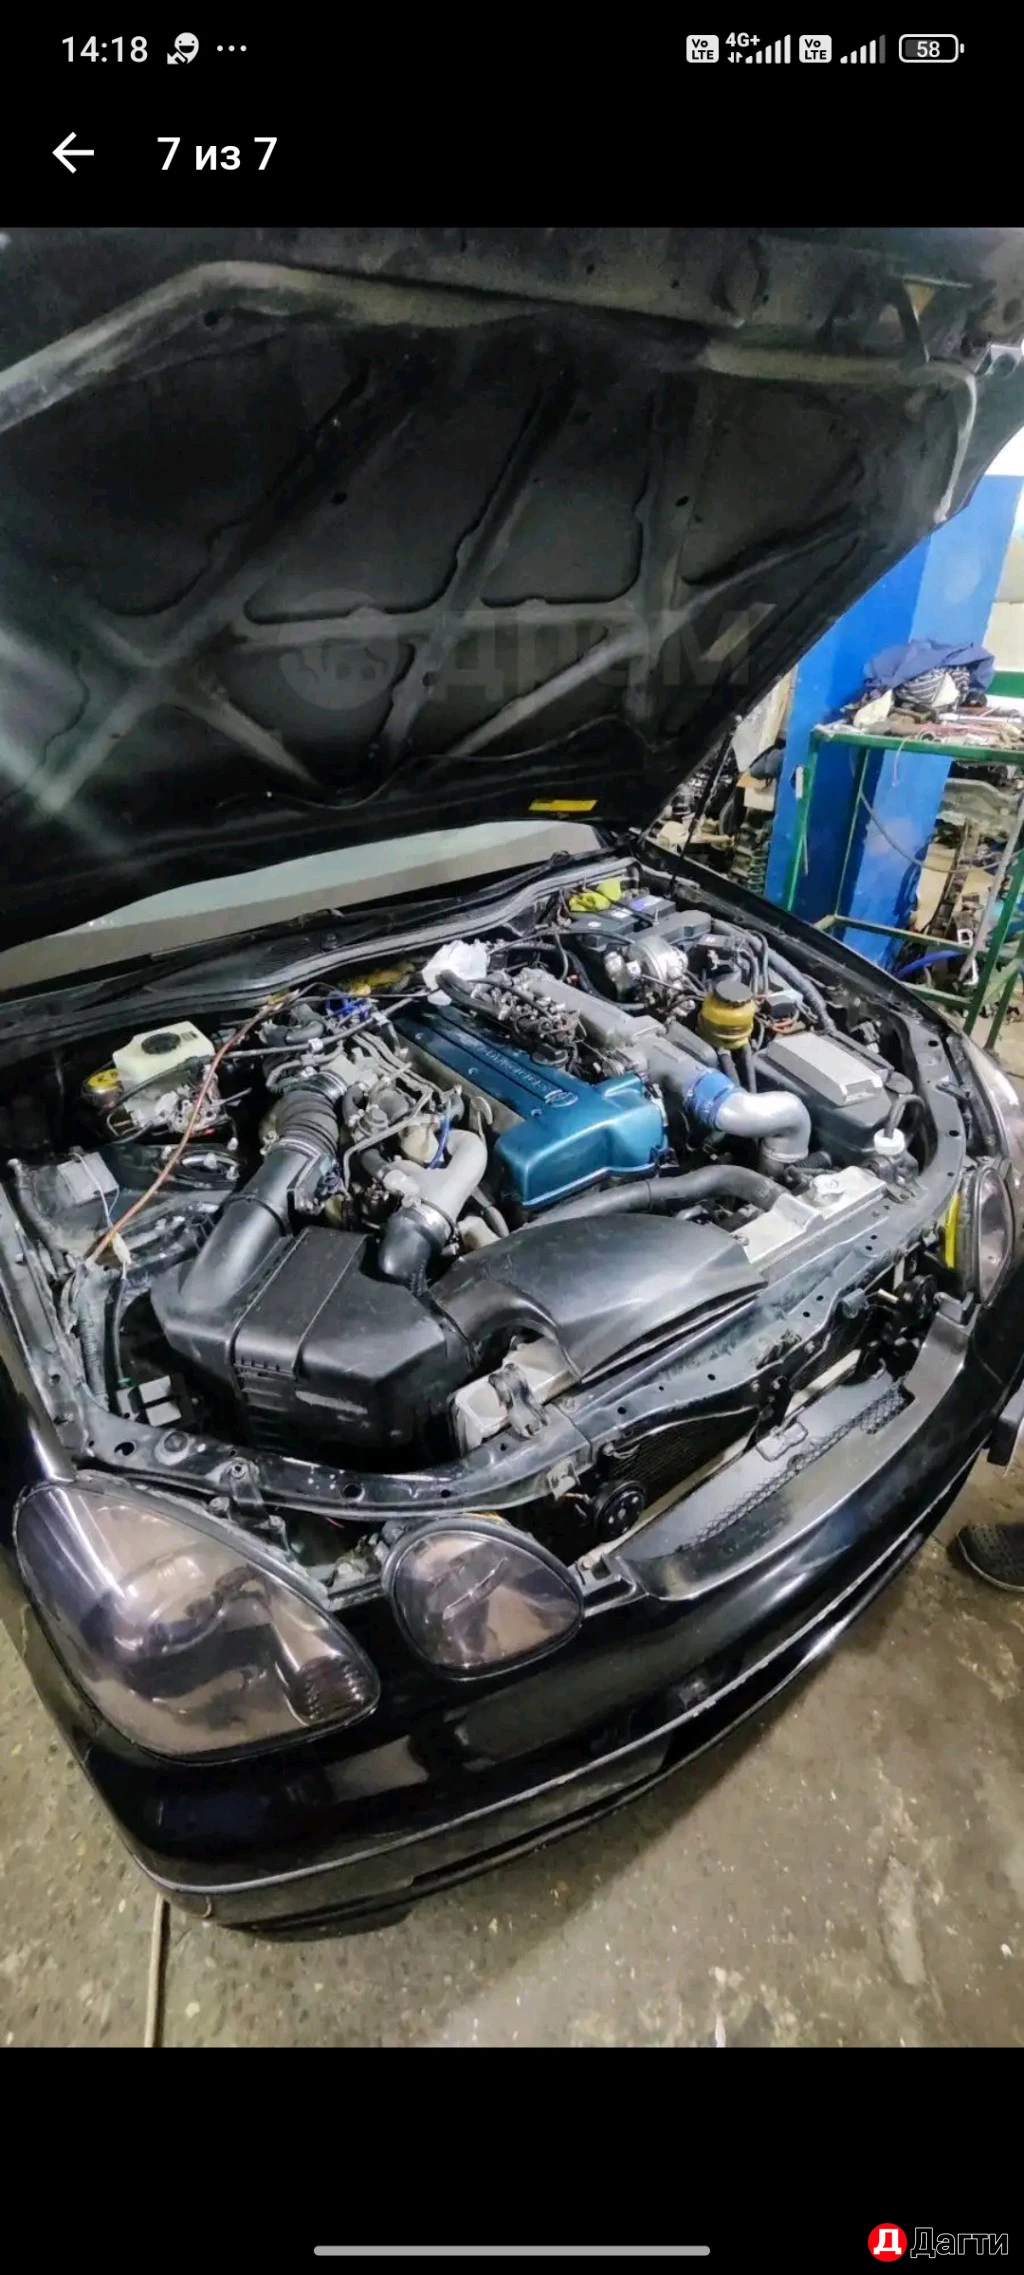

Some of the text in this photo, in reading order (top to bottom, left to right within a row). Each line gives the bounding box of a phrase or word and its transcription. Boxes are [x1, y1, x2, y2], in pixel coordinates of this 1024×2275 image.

[691, 38, 709, 49] Vo
[725, 32, 761, 48] 4G+
[804, 38, 822, 49] Vo
[62, 35, 148, 63] 14:18
[691, 49, 714, 60] LTE
[804, 49, 827, 60] LTE
[916, 40, 940, 58] 58
[157, 136, 278, 171] 7 из 7
